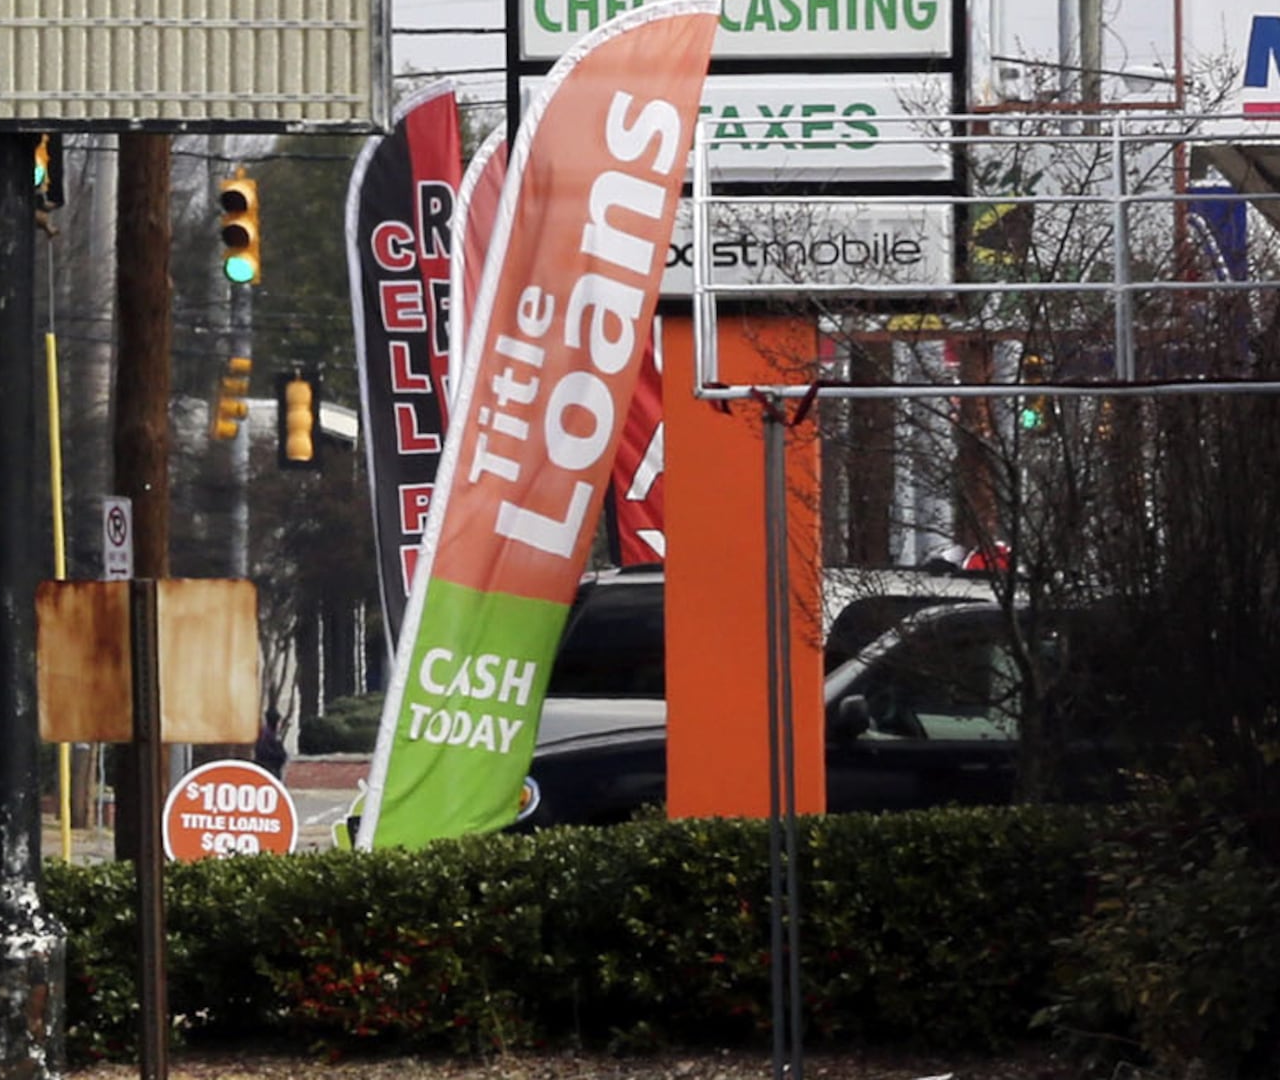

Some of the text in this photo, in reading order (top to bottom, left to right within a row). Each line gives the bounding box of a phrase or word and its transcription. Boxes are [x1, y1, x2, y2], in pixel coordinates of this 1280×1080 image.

[494, 90, 682, 560] Loans
[468, 285, 555, 487] Title
[420, 648, 536, 706] CASH
[410, 702, 523, 754] TODAY
[180, 813, 281, 833] TITLE LOANS
